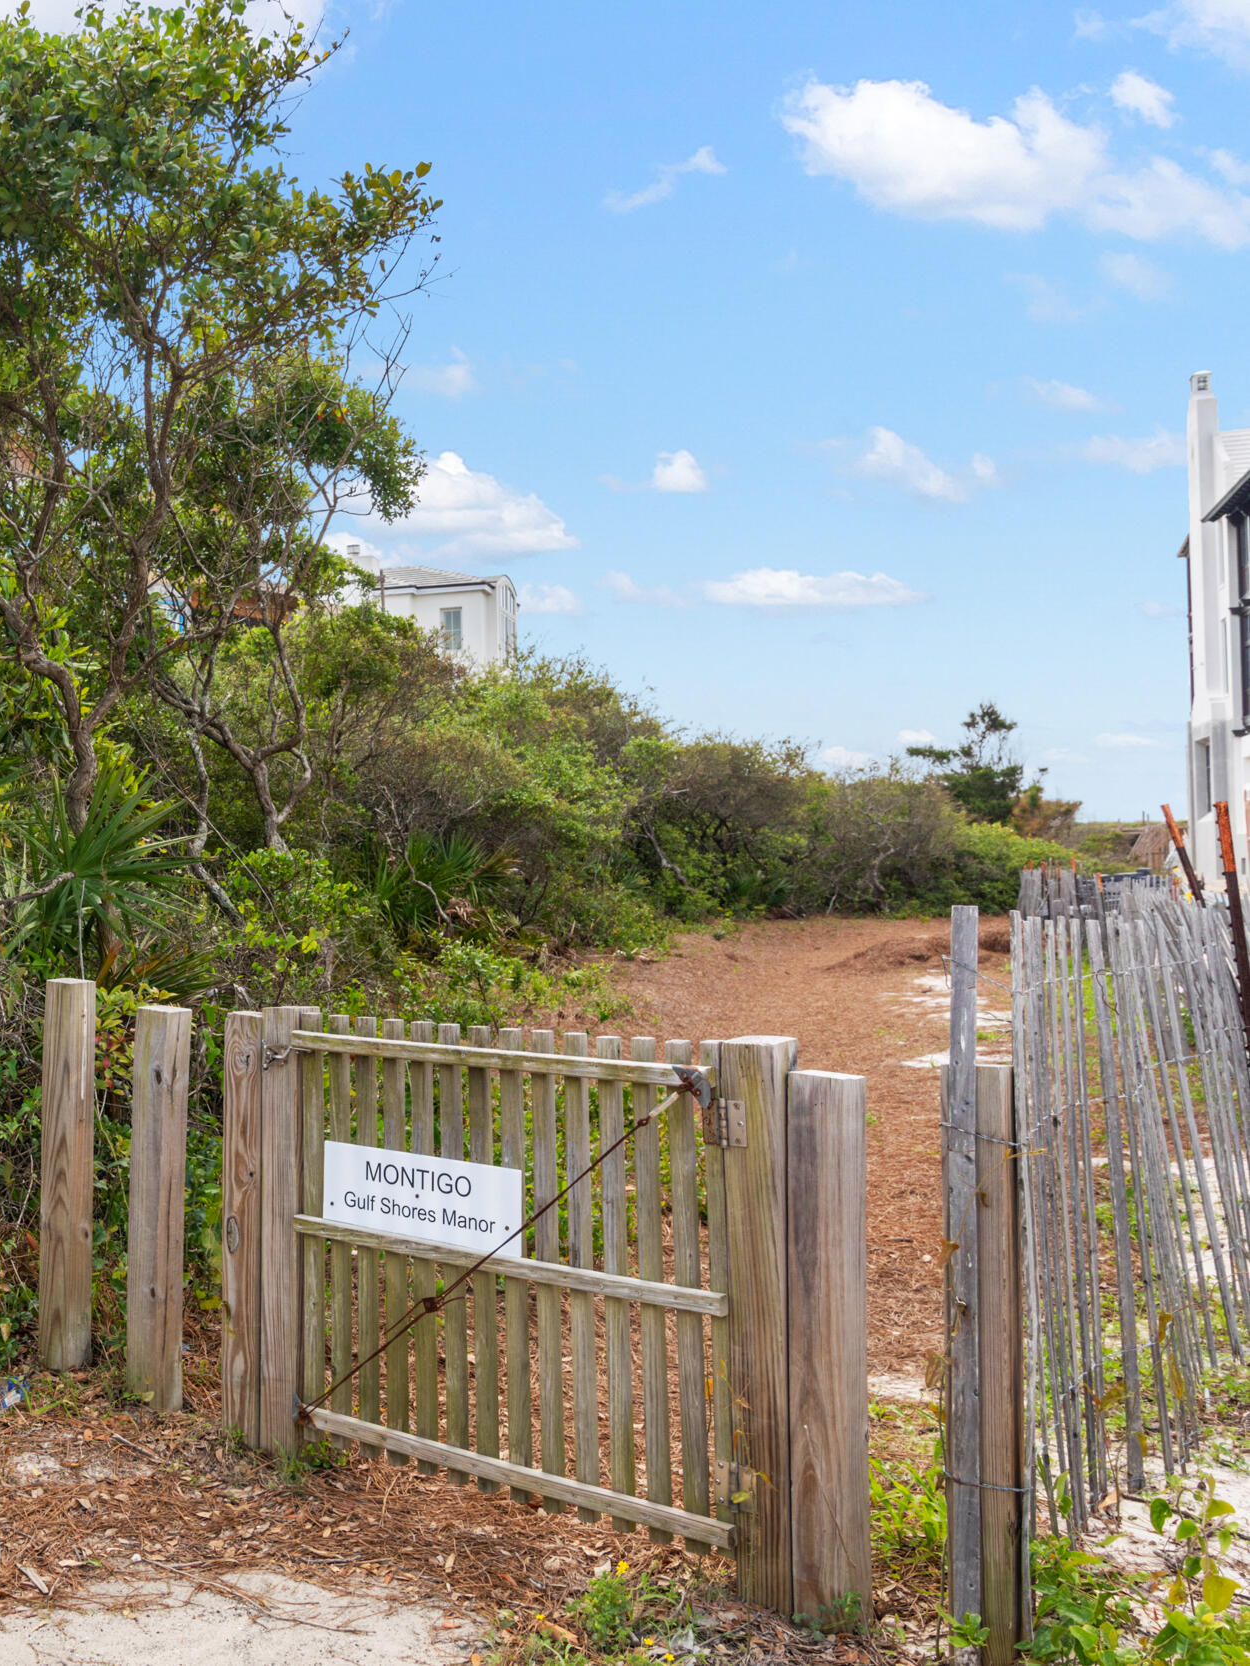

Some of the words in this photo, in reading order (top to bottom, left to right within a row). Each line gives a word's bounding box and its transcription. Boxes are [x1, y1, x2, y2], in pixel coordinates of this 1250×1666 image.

[365, 1161, 471, 1197] MONTIGO
[344, 1191, 375, 1211] Gulf
[380, 1198, 436, 1223] Shores
[442, 1208, 495, 1234] Manor
